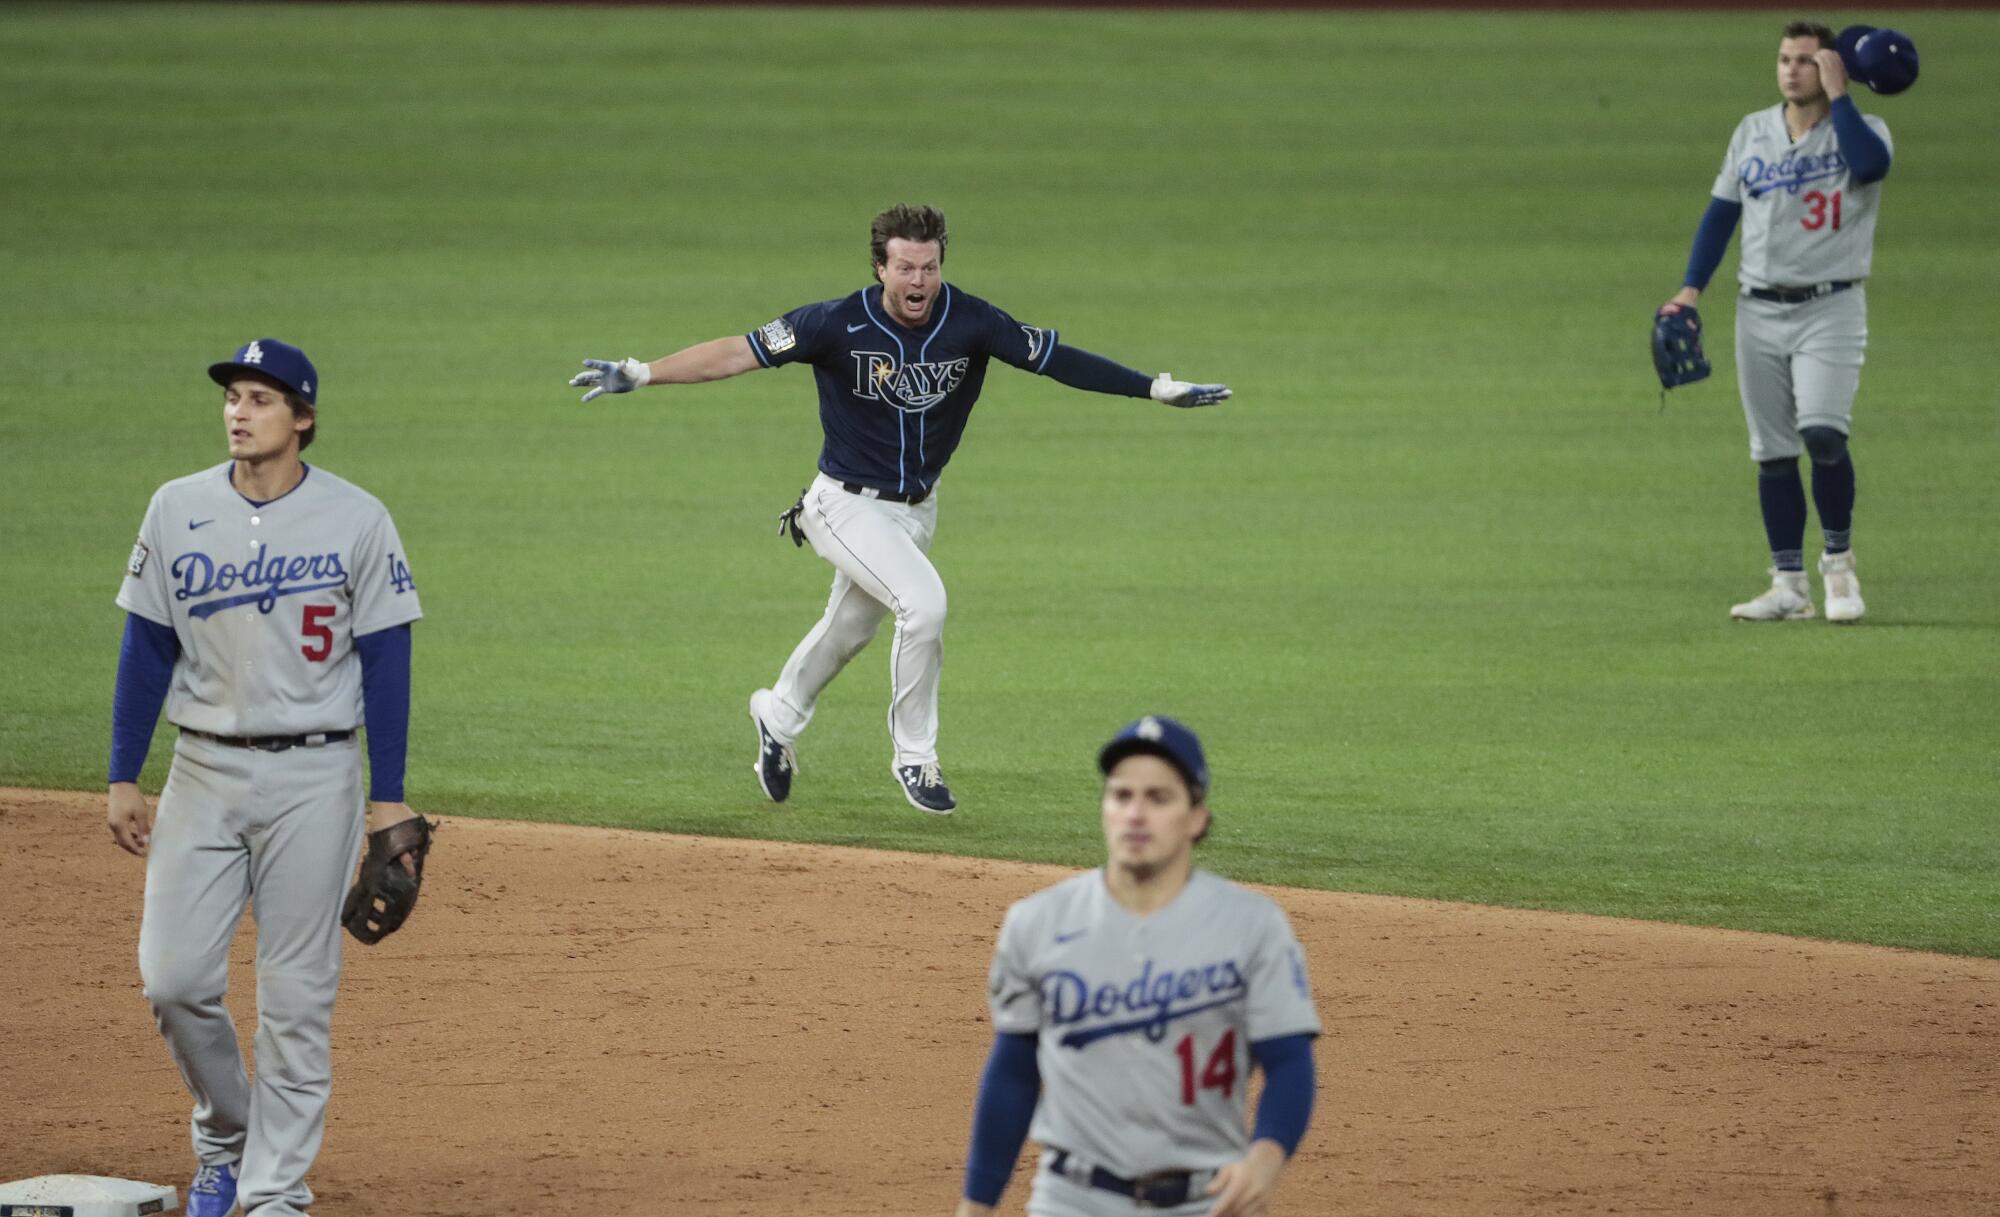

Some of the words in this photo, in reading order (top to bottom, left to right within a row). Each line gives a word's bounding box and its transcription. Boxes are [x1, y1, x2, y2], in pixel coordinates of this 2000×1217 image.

[1801, 190, 1841, 231] 31
[851, 350, 969, 413] RAYS
[171, 544, 348, 621] Dodgers
[388, 553, 416, 594] LA
[301, 605, 336, 662] 5
[1040, 959, 1247, 1049] Dodgers
[1175, 1027, 1236, 1105] 14
